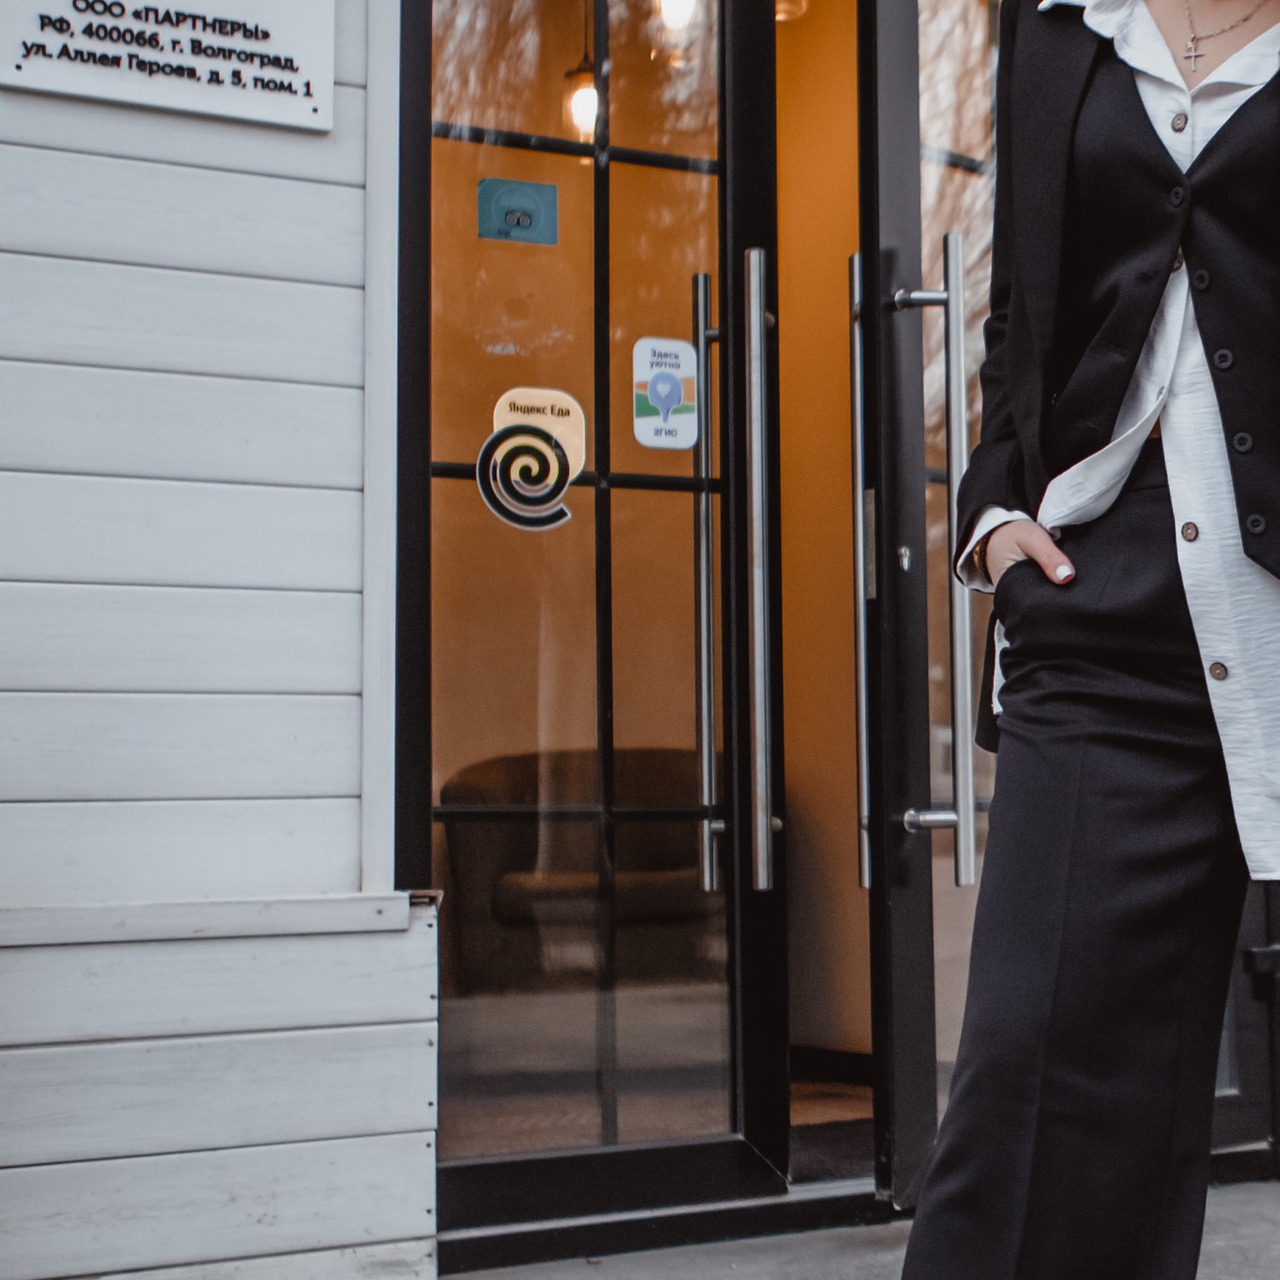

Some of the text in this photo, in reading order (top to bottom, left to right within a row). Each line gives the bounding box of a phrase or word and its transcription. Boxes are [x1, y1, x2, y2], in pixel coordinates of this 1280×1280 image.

[38, 13, 300, 73] РФ, 400066, г. Волгоград,
[131, 6, 271, 41] «ПАРТНЕРЫ»
[22, 40, 53, 59] ул.
[57, 43, 122, 68] Аллея
[127, 53, 201, 82] Героев,
[207, 70, 224, 85] д.
[253, 75, 297, 95] пом.
[303, 81, 313, 97] 1
[508, 402, 570, 417] Яндекс Еда
